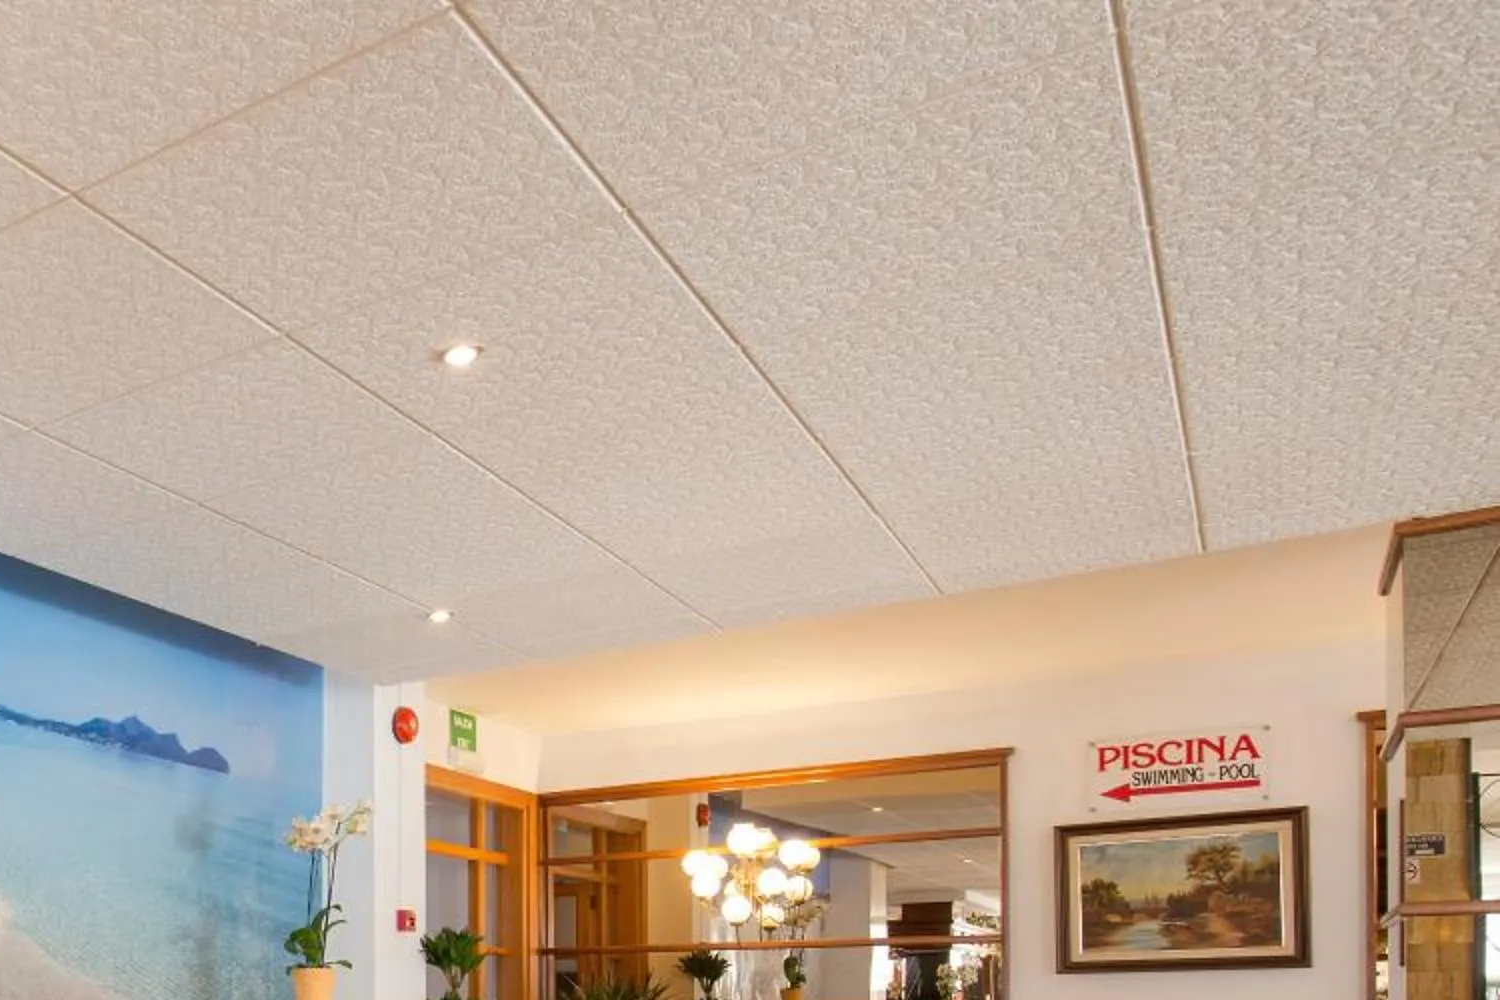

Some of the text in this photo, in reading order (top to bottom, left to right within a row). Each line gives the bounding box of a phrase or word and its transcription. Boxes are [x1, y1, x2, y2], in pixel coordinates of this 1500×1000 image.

[1097, 734, 1261, 772] PISCINA
[1131, 767, 1204, 787] SWIMMING
[1219, 763, 1259, 781] POOL
